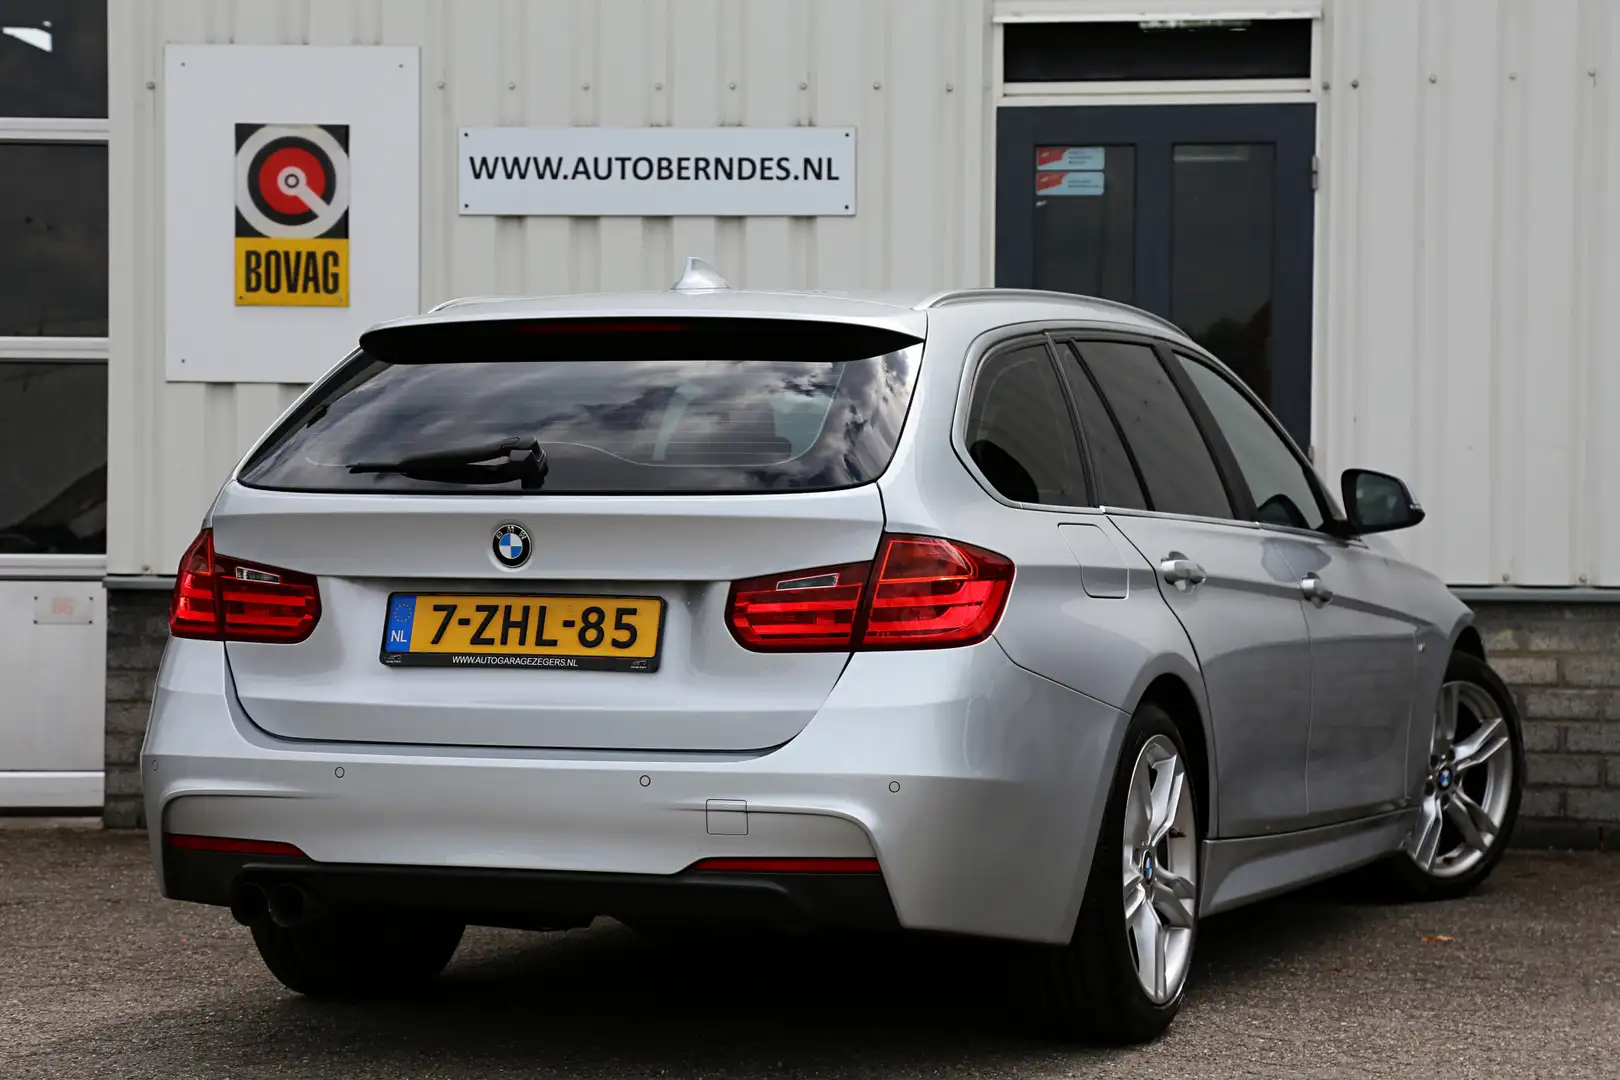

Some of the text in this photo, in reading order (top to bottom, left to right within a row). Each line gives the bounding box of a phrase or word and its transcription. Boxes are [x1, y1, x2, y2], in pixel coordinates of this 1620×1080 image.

[469, 156, 840, 181] WWW.AUTOBERNDES.NL
[244, 249, 340, 294] BOVAG
[390, 630, 408, 642] NL
[430, 604, 638, 649] 7-ZHL-85
[452, 655, 578, 667] WWW.AUTOGARAGEZEGERS.NL
